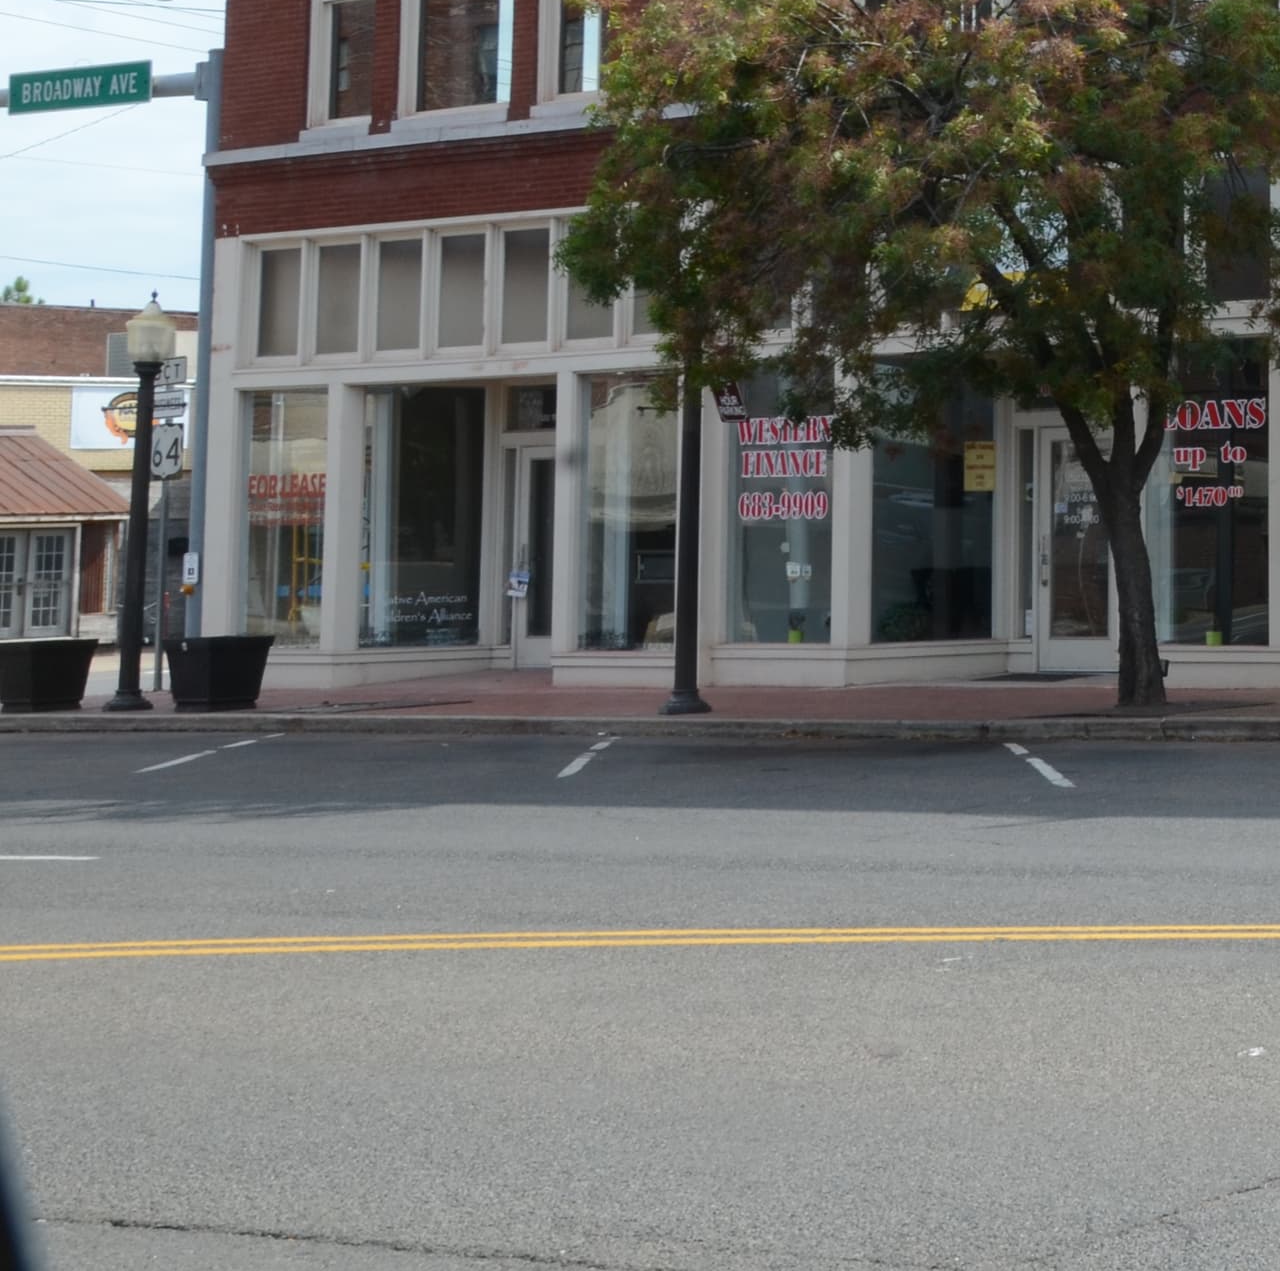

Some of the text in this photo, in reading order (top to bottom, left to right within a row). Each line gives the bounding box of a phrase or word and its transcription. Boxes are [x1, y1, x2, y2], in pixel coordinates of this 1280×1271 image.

[22, 72, 138, 104] BROADWAY AVE
[1163, 396, 1266, 430] LOANS
[738, 415, 834, 445] WESTERN
[152, 437, 180, 467] 64
[741, 449, 827, 478] FINANCE
[1173, 440, 1247, 471] up to
[248, 472, 327, 499] FOR LEASE
[738, 491, 828, 520] 683-9909
